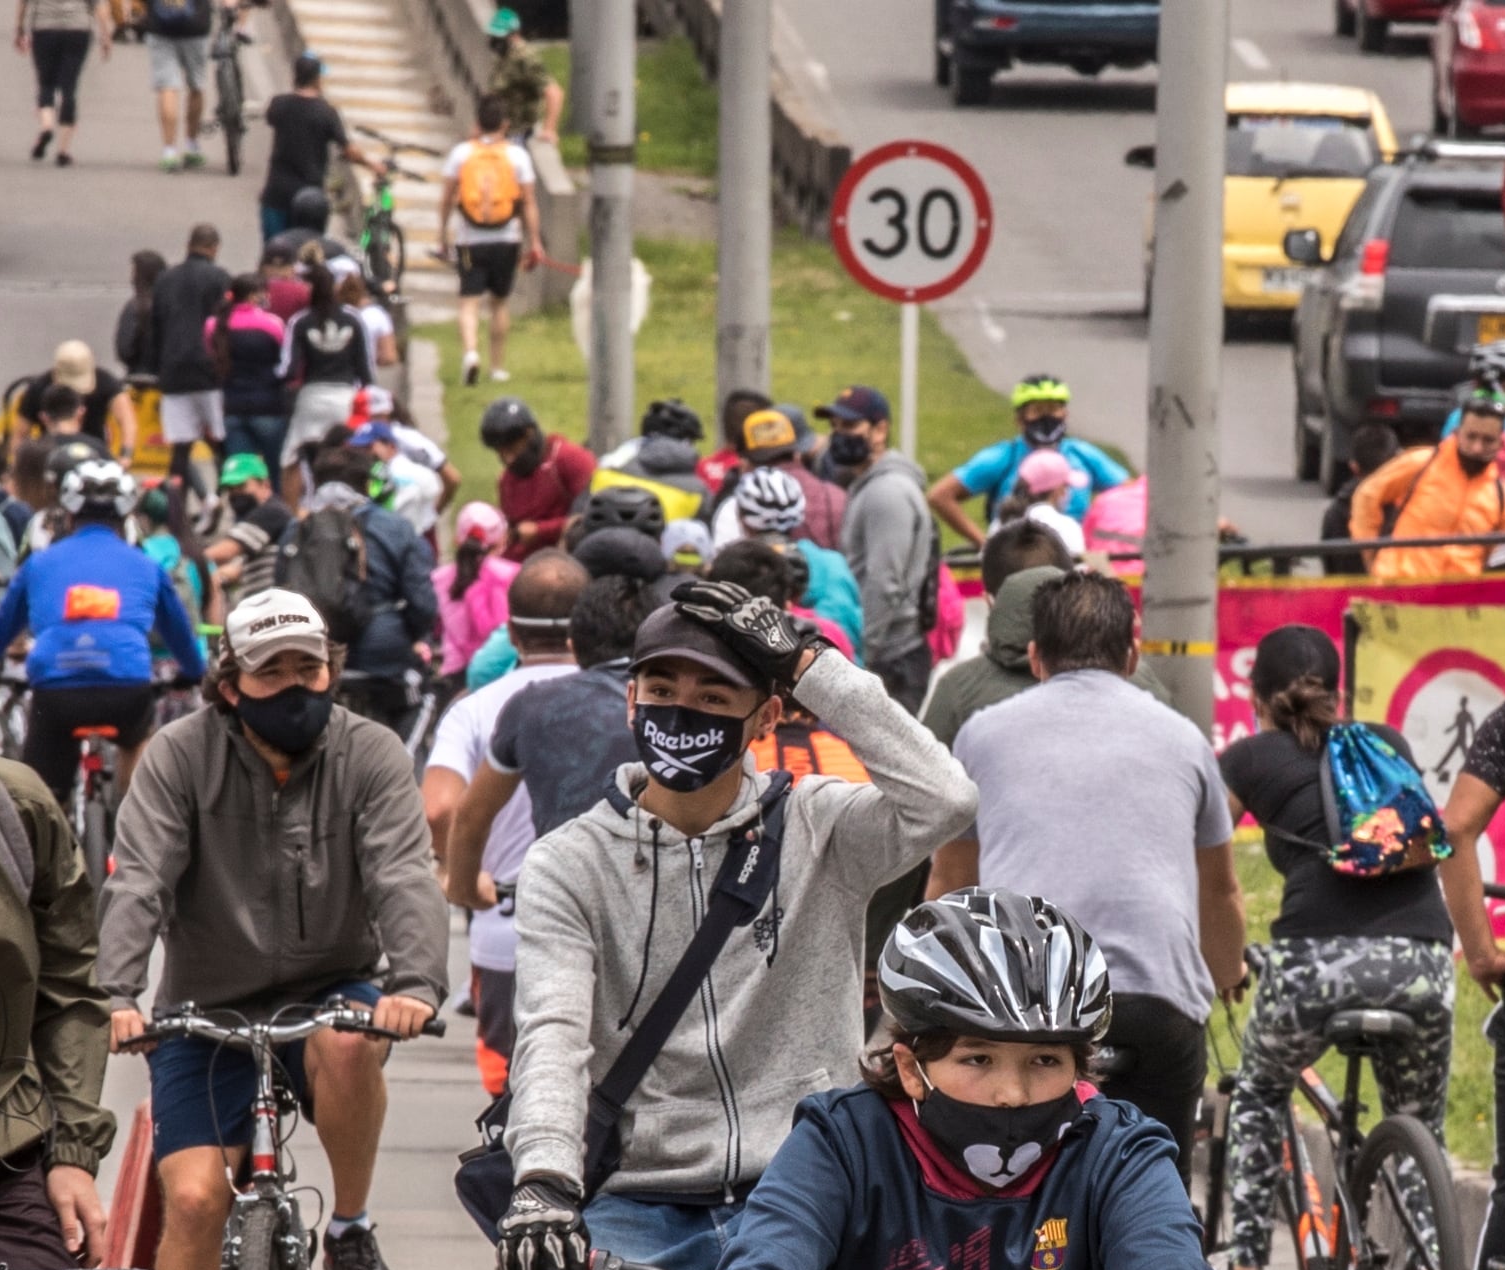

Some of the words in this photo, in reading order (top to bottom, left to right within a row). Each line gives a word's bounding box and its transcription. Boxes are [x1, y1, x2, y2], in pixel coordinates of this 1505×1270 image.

[862, 187, 961, 259] 30
[644, 719, 725, 750] Reebok
[737, 845, 760, 884] adidas
